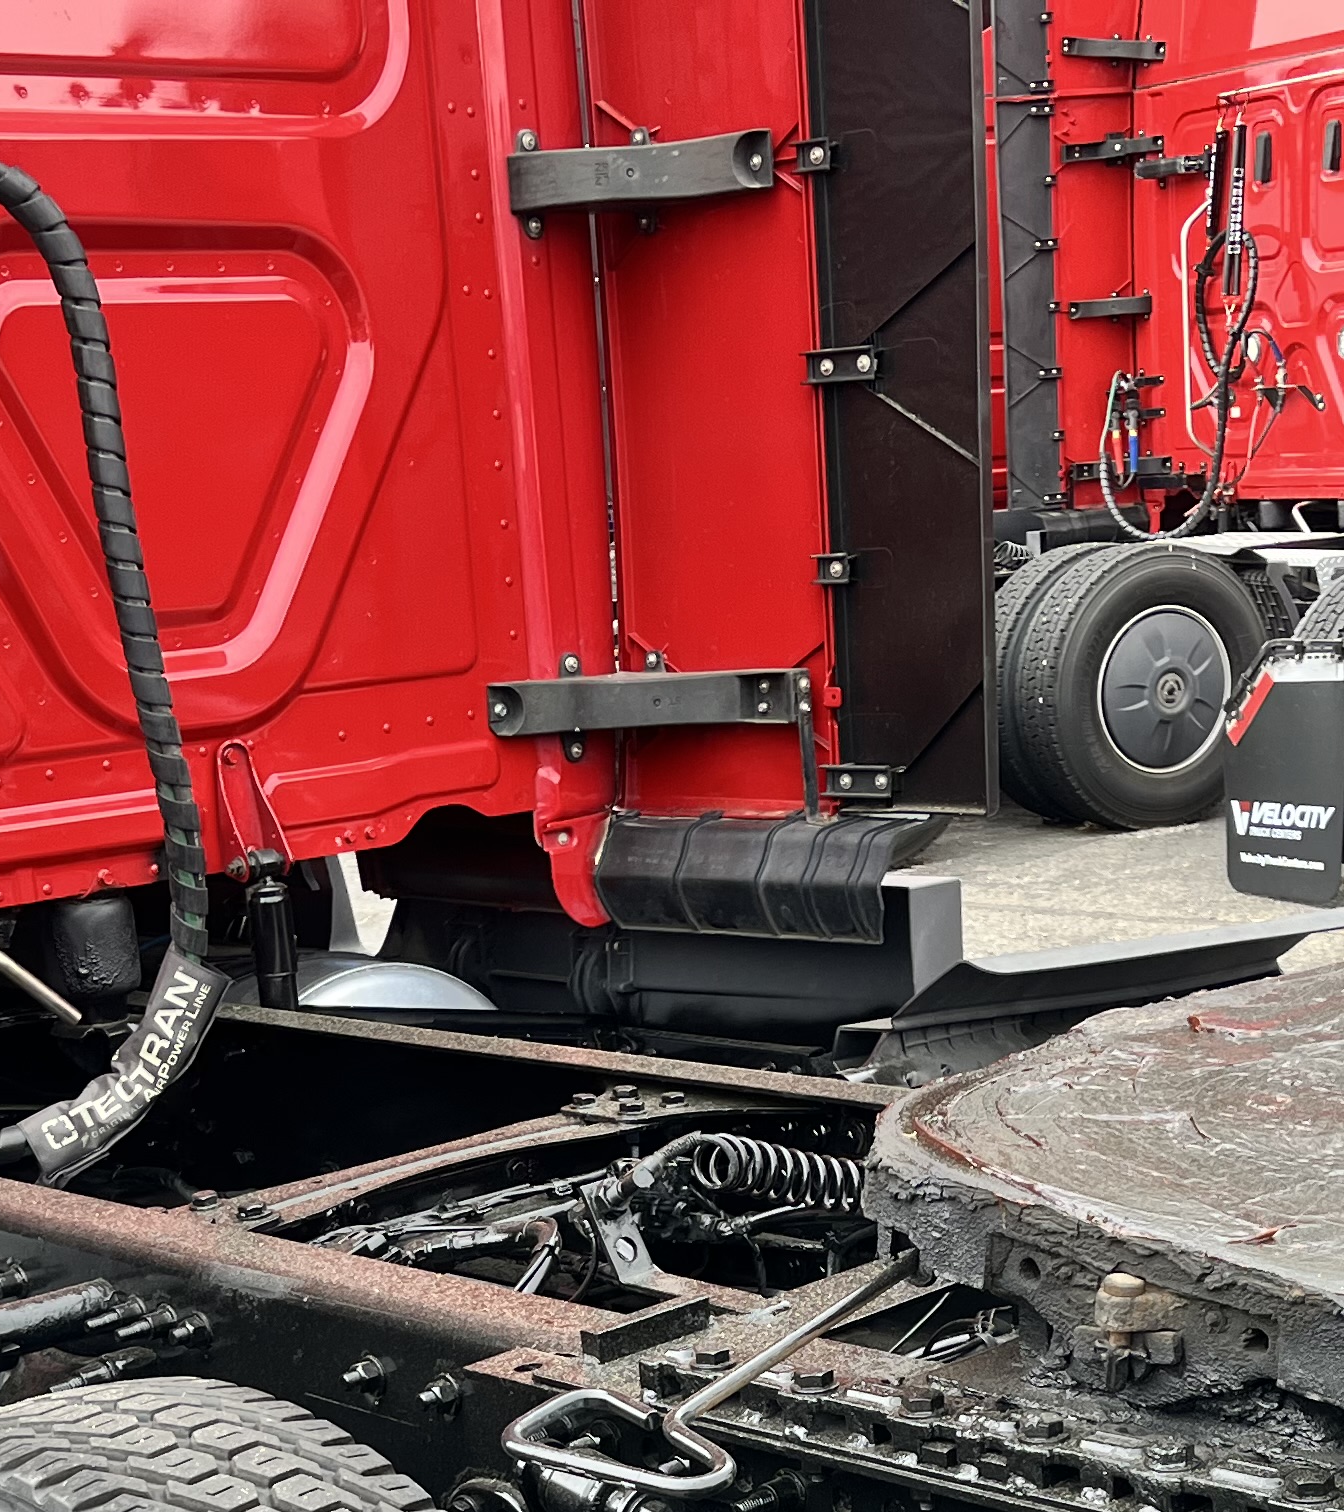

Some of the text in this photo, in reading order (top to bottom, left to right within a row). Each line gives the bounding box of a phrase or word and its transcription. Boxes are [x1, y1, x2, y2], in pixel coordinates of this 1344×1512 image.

[1250, 801, 1336, 830] VELOCITY
[190, 983, 212, 1019] LINE
[68, 970, 199, 1129] TECTRAN
[90, 1103, 144, 1139] ORIGINAL
